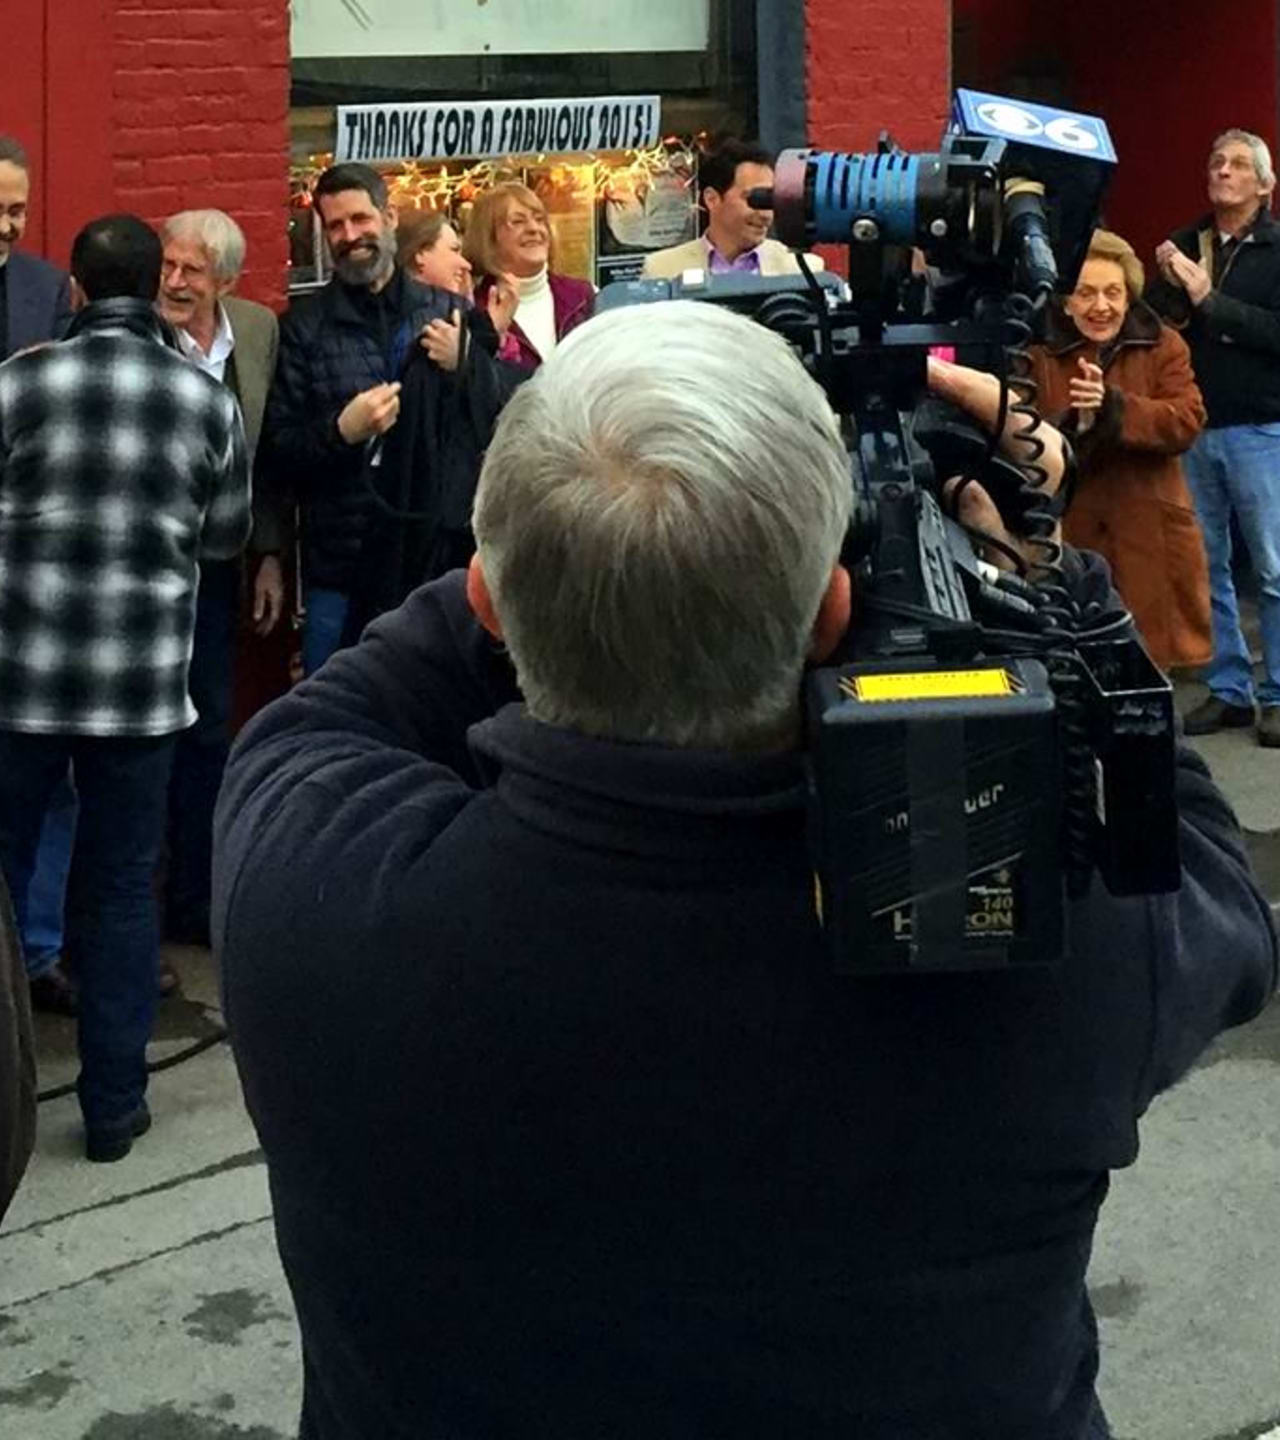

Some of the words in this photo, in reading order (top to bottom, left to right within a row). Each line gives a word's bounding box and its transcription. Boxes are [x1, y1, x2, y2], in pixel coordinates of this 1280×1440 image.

[346, 111, 427, 160] THANKS
[431, 109, 475, 157] FOR
[479, 107, 495, 154] A
[498, 105, 595, 154] FABULOUS
[599, 103, 653, 150] 2015!
[983, 896, 1013, 911] 140
